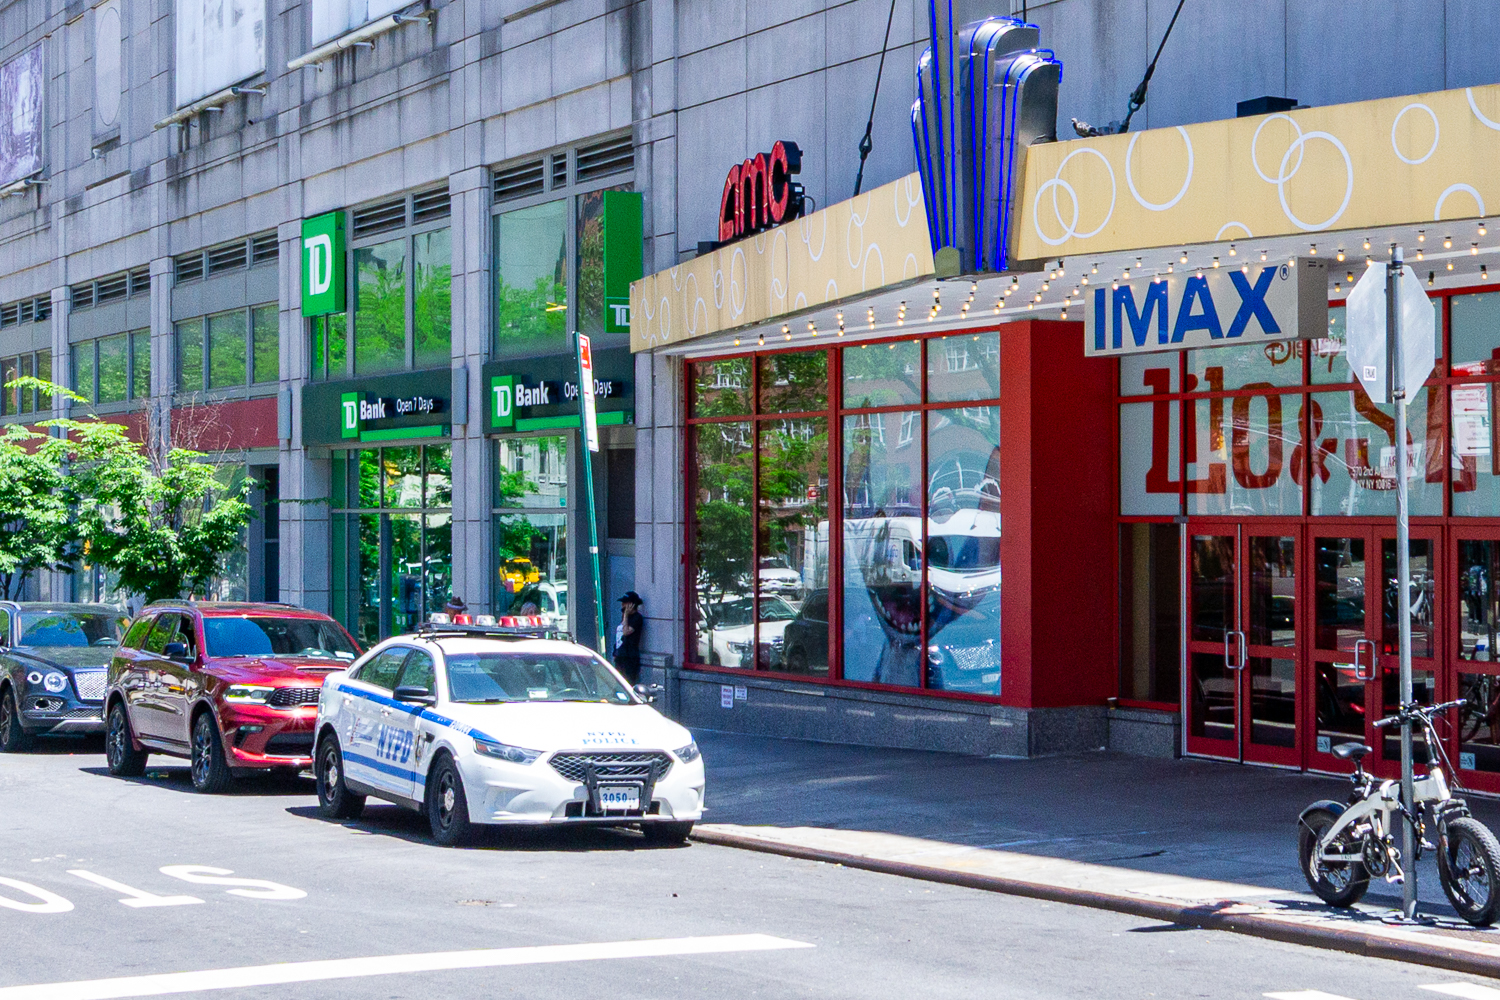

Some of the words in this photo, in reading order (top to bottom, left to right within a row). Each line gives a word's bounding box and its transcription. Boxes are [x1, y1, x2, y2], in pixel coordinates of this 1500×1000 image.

[718, 140, 789, 241] amc
[304, 233, 332, 296] TD
[1094, 265, 1283, 351] IMAX
[343, 401, 357, 429] TD
[360, 398, 386, 421] Bank
[396, 398, 413, 413] Open
[413, 397, 417, 410] 7
[418, 398, 434, 414] Days
[493, 385, 512, 417] TD
[515, 381, 549, 407] Bank
[564, 381, 579, 400] Ope
[594, 379, 613, 399] Days
[1143, 366, 1284, 494] Lilo
[376, 724, 414, 764] NYPD
[602, 792, 628, 803] 3050
